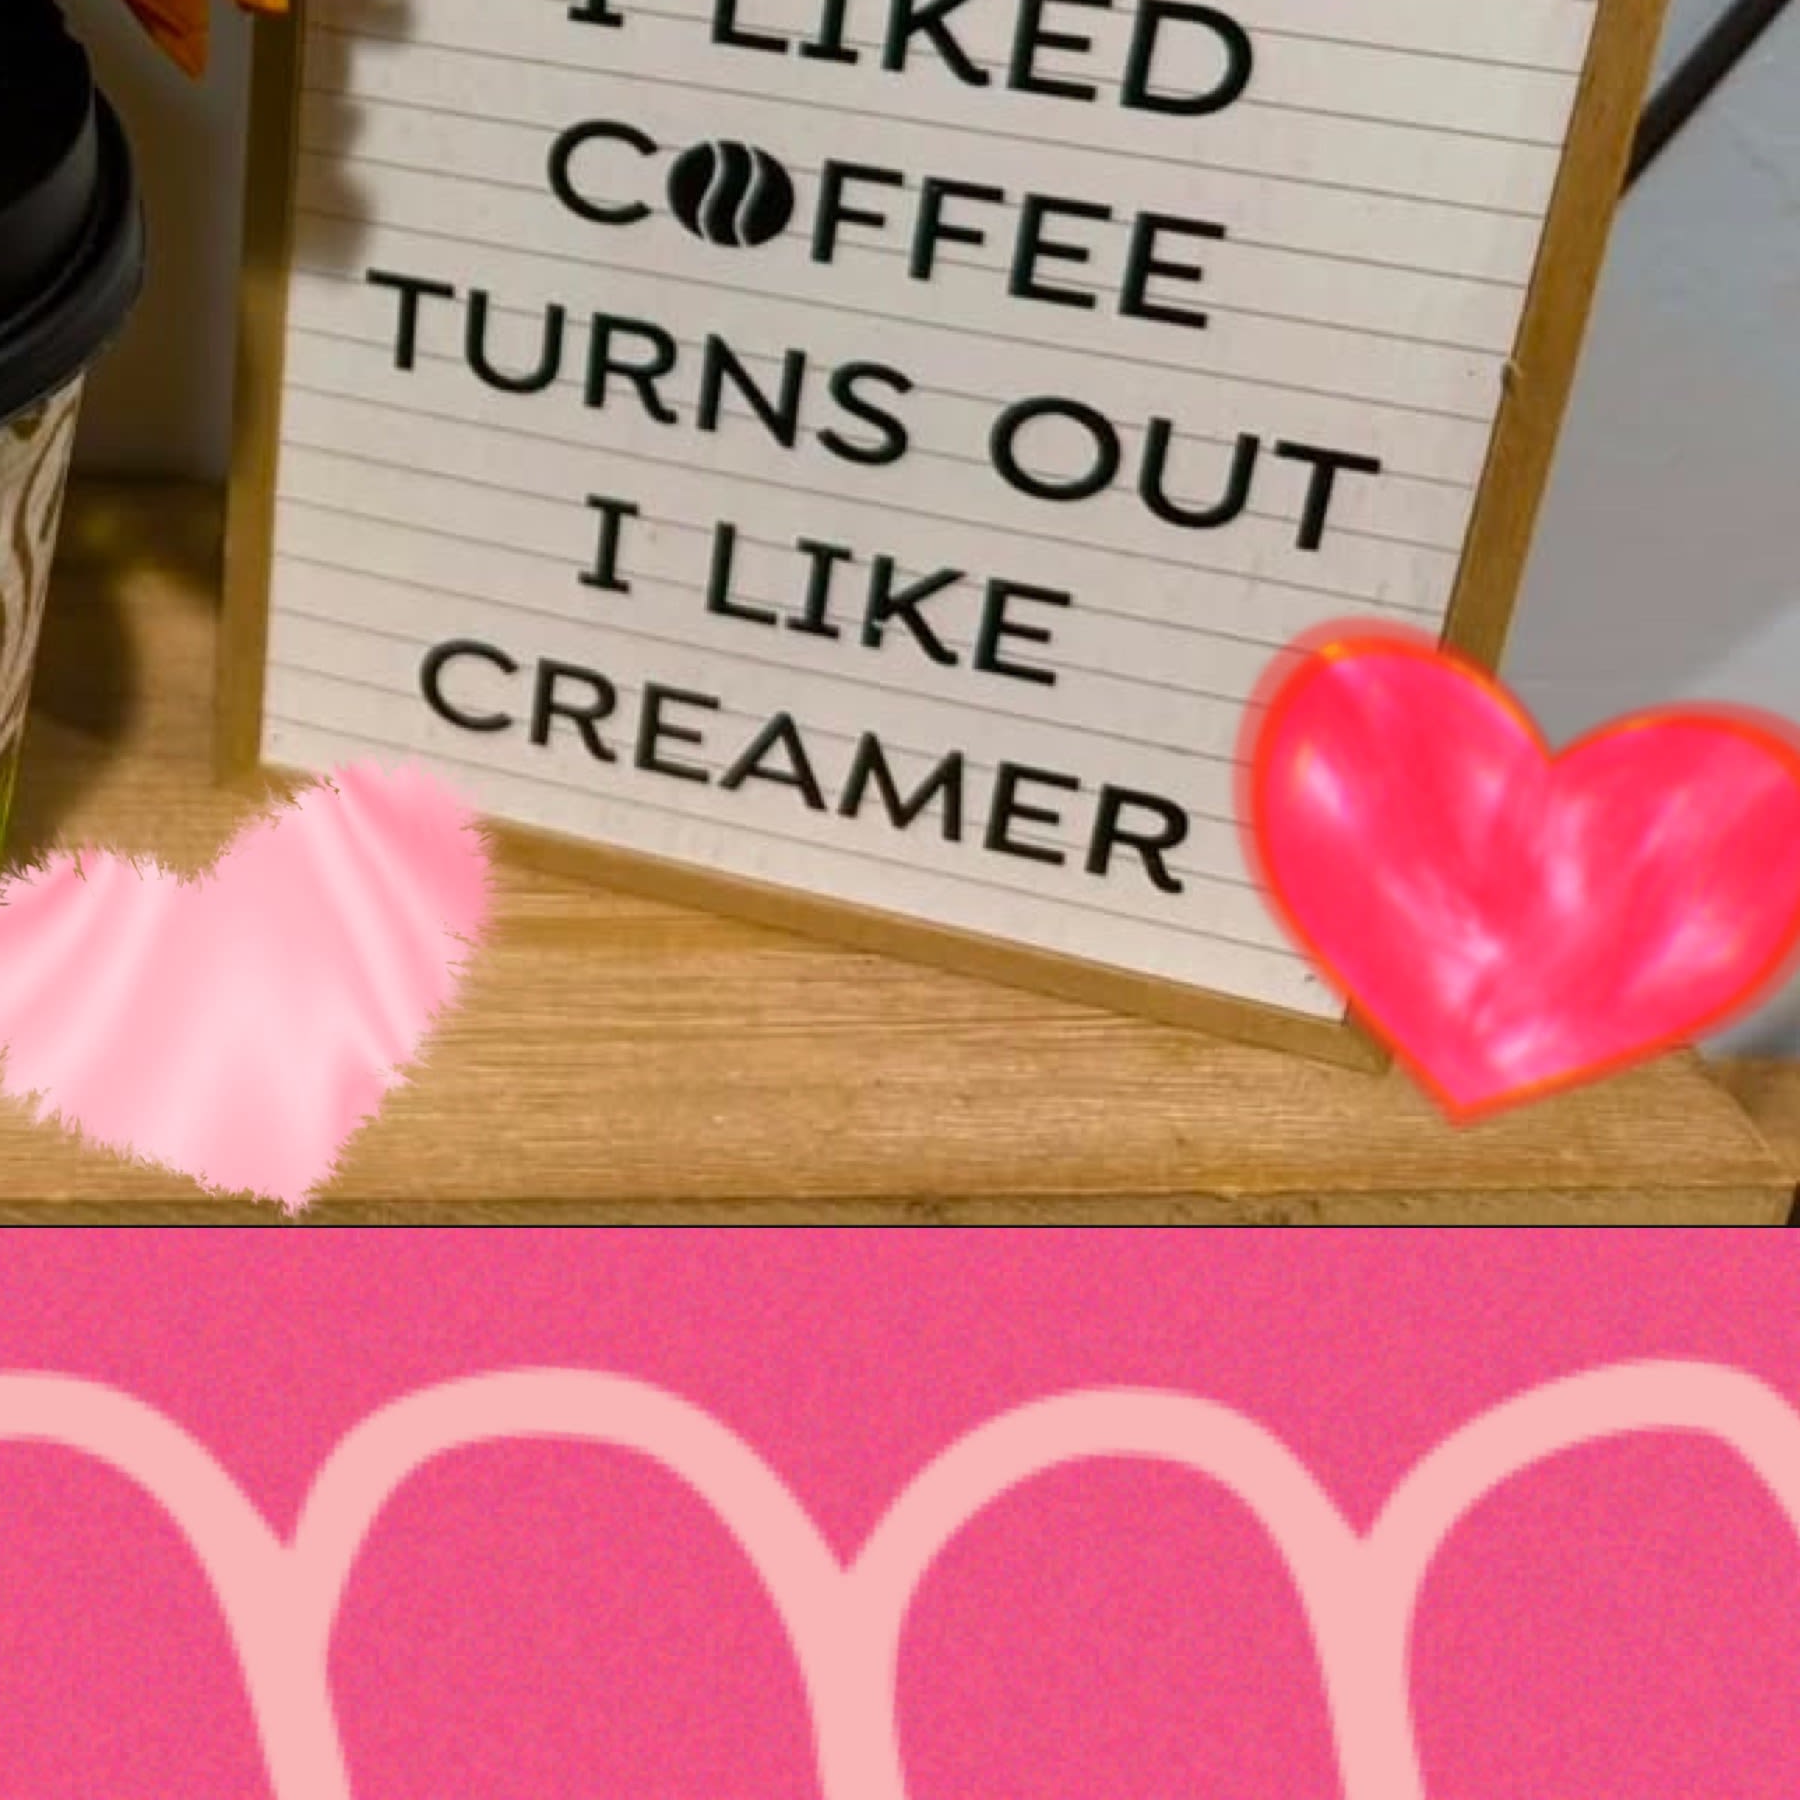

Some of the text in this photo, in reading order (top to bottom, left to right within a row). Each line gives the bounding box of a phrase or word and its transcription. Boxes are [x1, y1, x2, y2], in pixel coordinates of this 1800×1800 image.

[366, 268, 1382, 552] TURNS OUT
[579, 495, 1073, 687] I LIKE
[421, 641, 1190, 896] CREAMER
